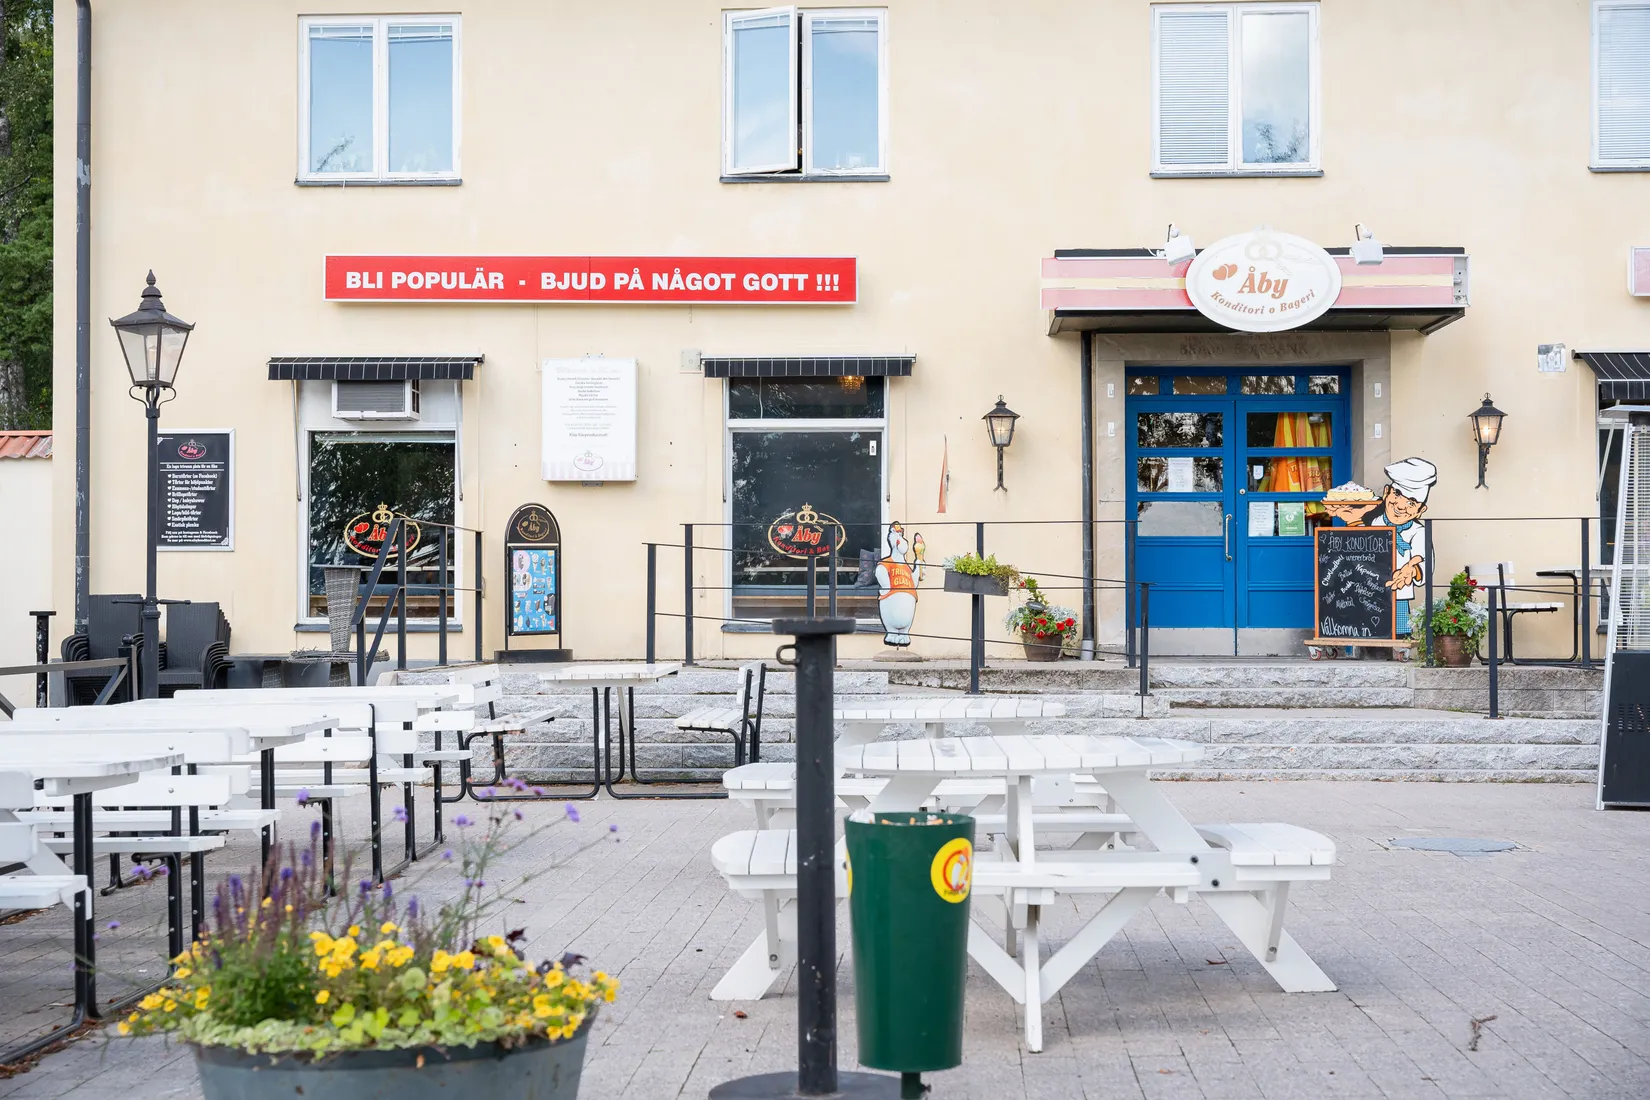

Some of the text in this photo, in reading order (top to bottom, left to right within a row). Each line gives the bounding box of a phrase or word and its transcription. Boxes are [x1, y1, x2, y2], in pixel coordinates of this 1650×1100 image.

[346, 272, 384, 290] BLI
[392, 267, 504, 290] POPULÄR
[542, 272, 606, 290] BJUD
[614, 267, 645, 290] PÅ
[652, 267, 736, 291] NÅGOT
[743, 273, 808, 291] GOTT
[816, 273, 839, 291] !!!
[1238, 266, 1289, 299] Åby
[1210, 290, 1264, 314] Konditori
[1280, 289, 1316, 312] Bageri
[350, 536, 381, 552] Konditor
[368, 524, 398, 543] Åb
[792, 525, 822, 545] Åby
[1320, 616, 1372, 638] Välkomna in
